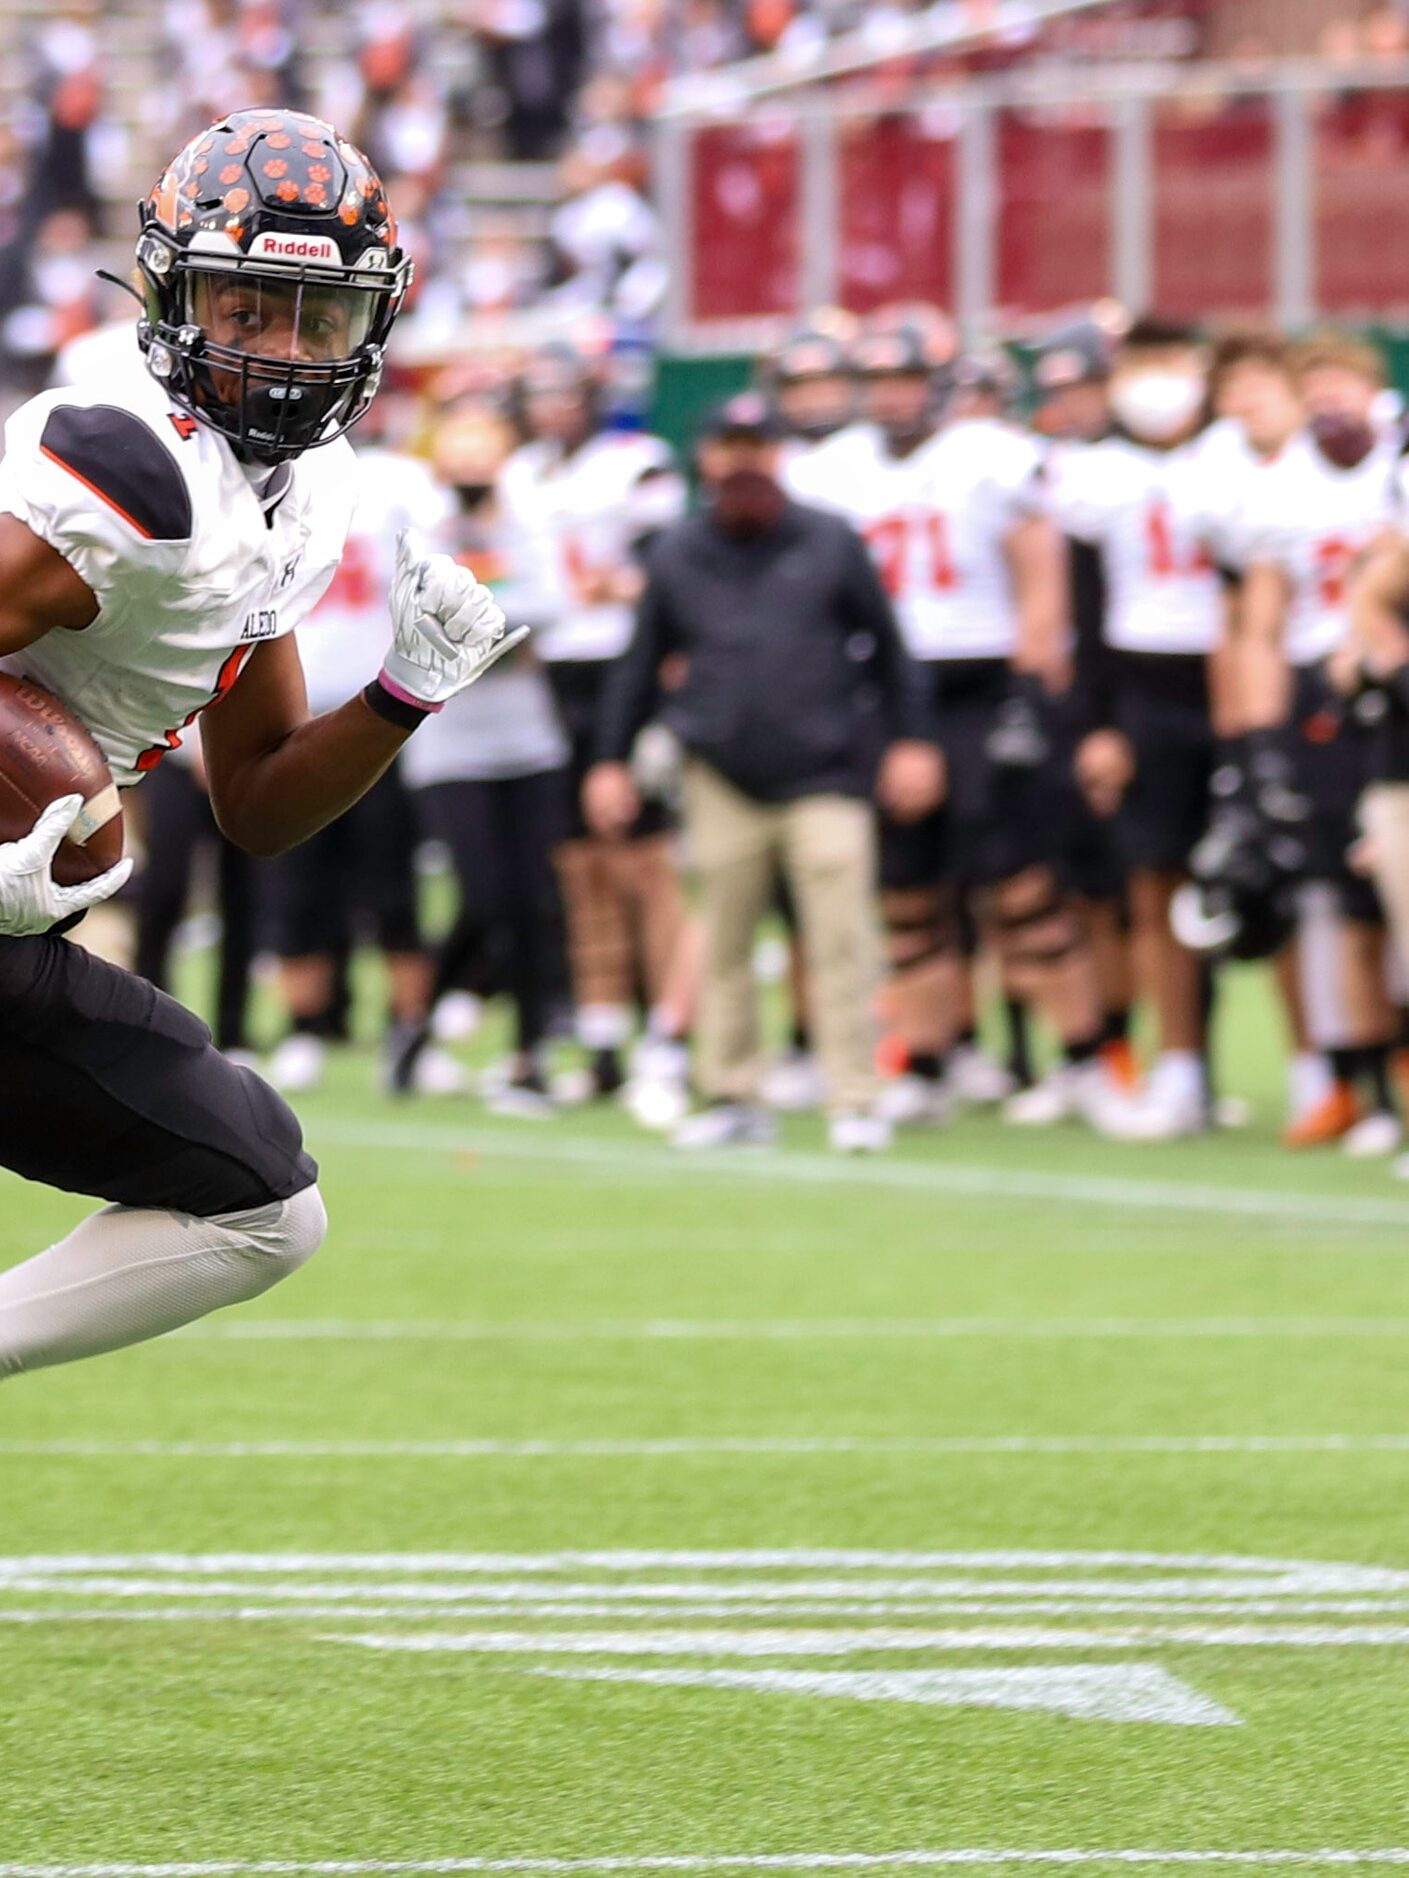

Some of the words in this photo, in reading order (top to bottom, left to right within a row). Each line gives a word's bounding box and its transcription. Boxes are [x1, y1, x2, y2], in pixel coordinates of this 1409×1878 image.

[263, 238, 332, 258] Riddell
[248, 427, 285, 443] Riddl
[240, 609, 277, 640] ALEDO
[9, 726, 49, 768] NCAA
